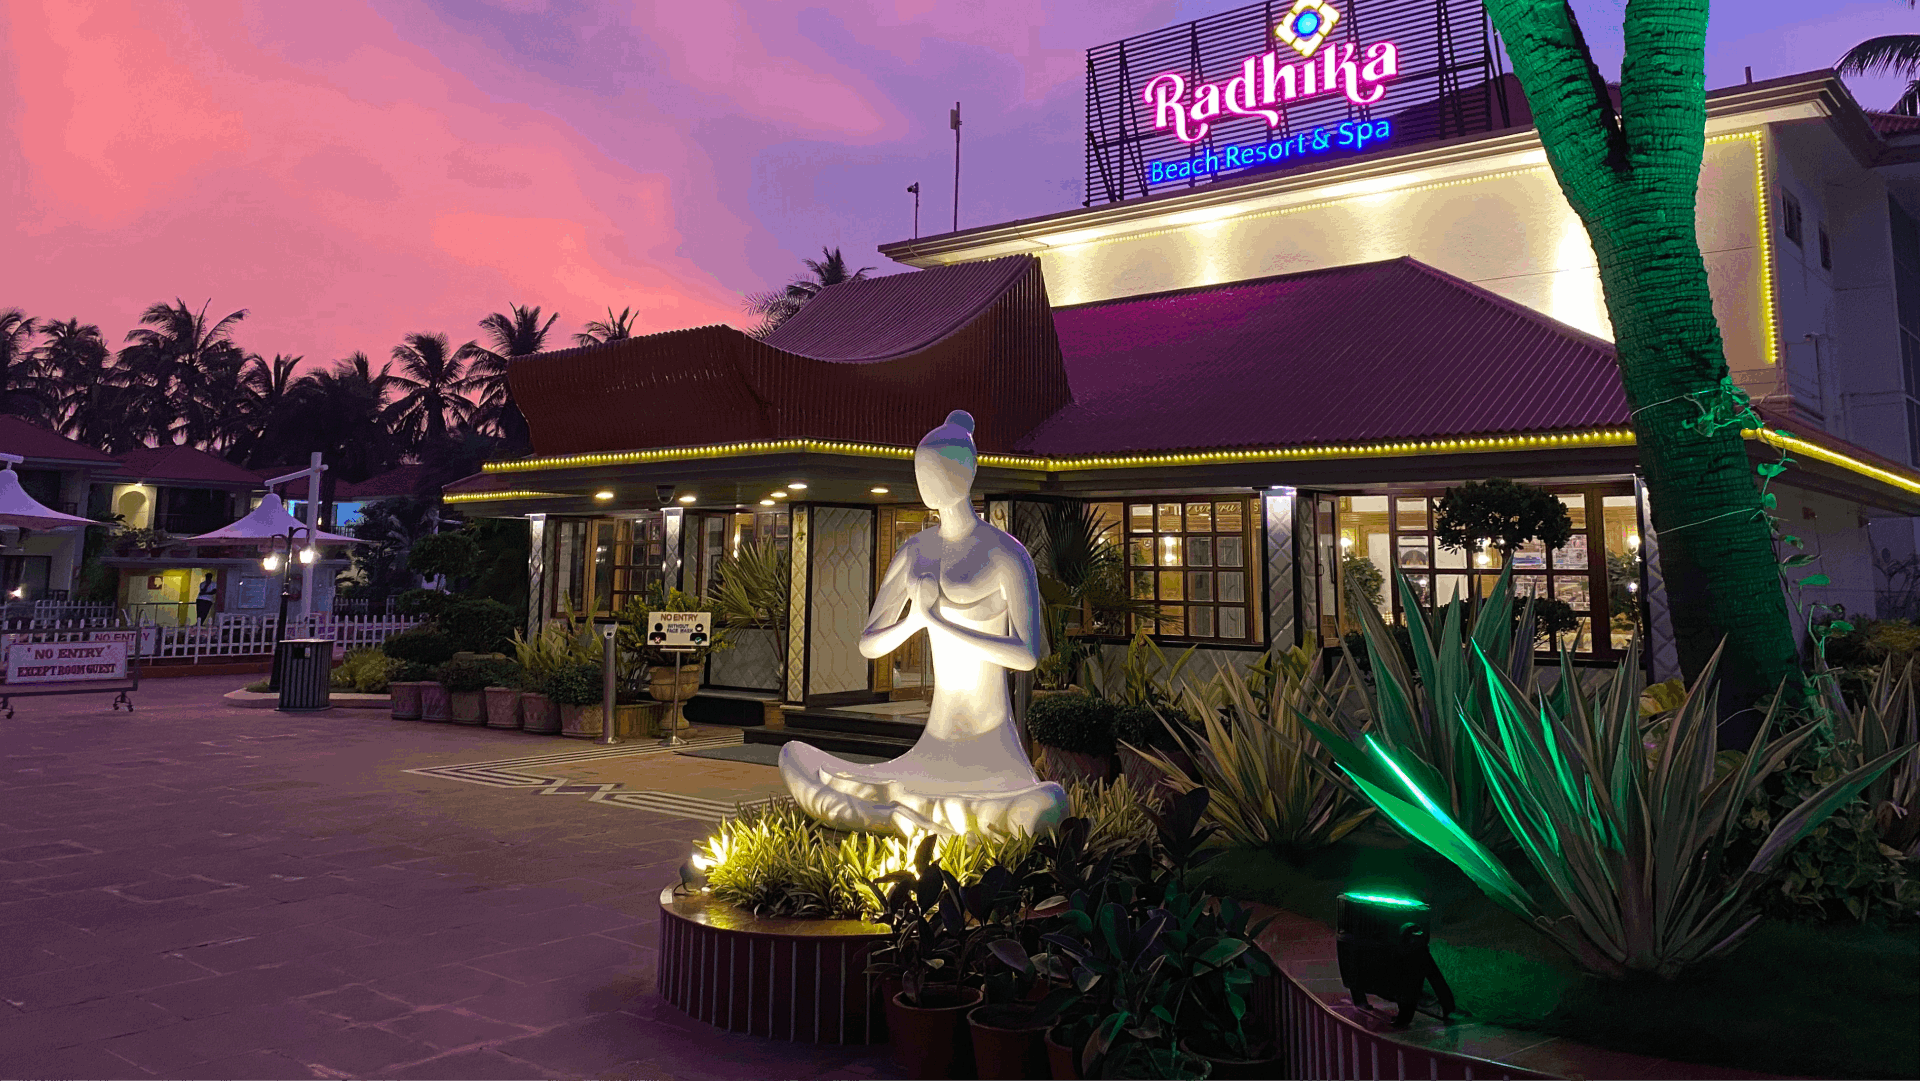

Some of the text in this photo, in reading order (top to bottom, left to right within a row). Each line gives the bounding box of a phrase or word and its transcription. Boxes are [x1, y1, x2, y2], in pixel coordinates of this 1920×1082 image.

[1144, 41, 1398, 142] Radhika
[1152, 120, 1390, 182] Beach Resort & Spa
[661, 613, 698, 621] NO ENTRY
[94, 632, 150, 641] NO ENTY
[57, 664, 86, 676] ROOM
[86, 663, 116, 674] GUEST
